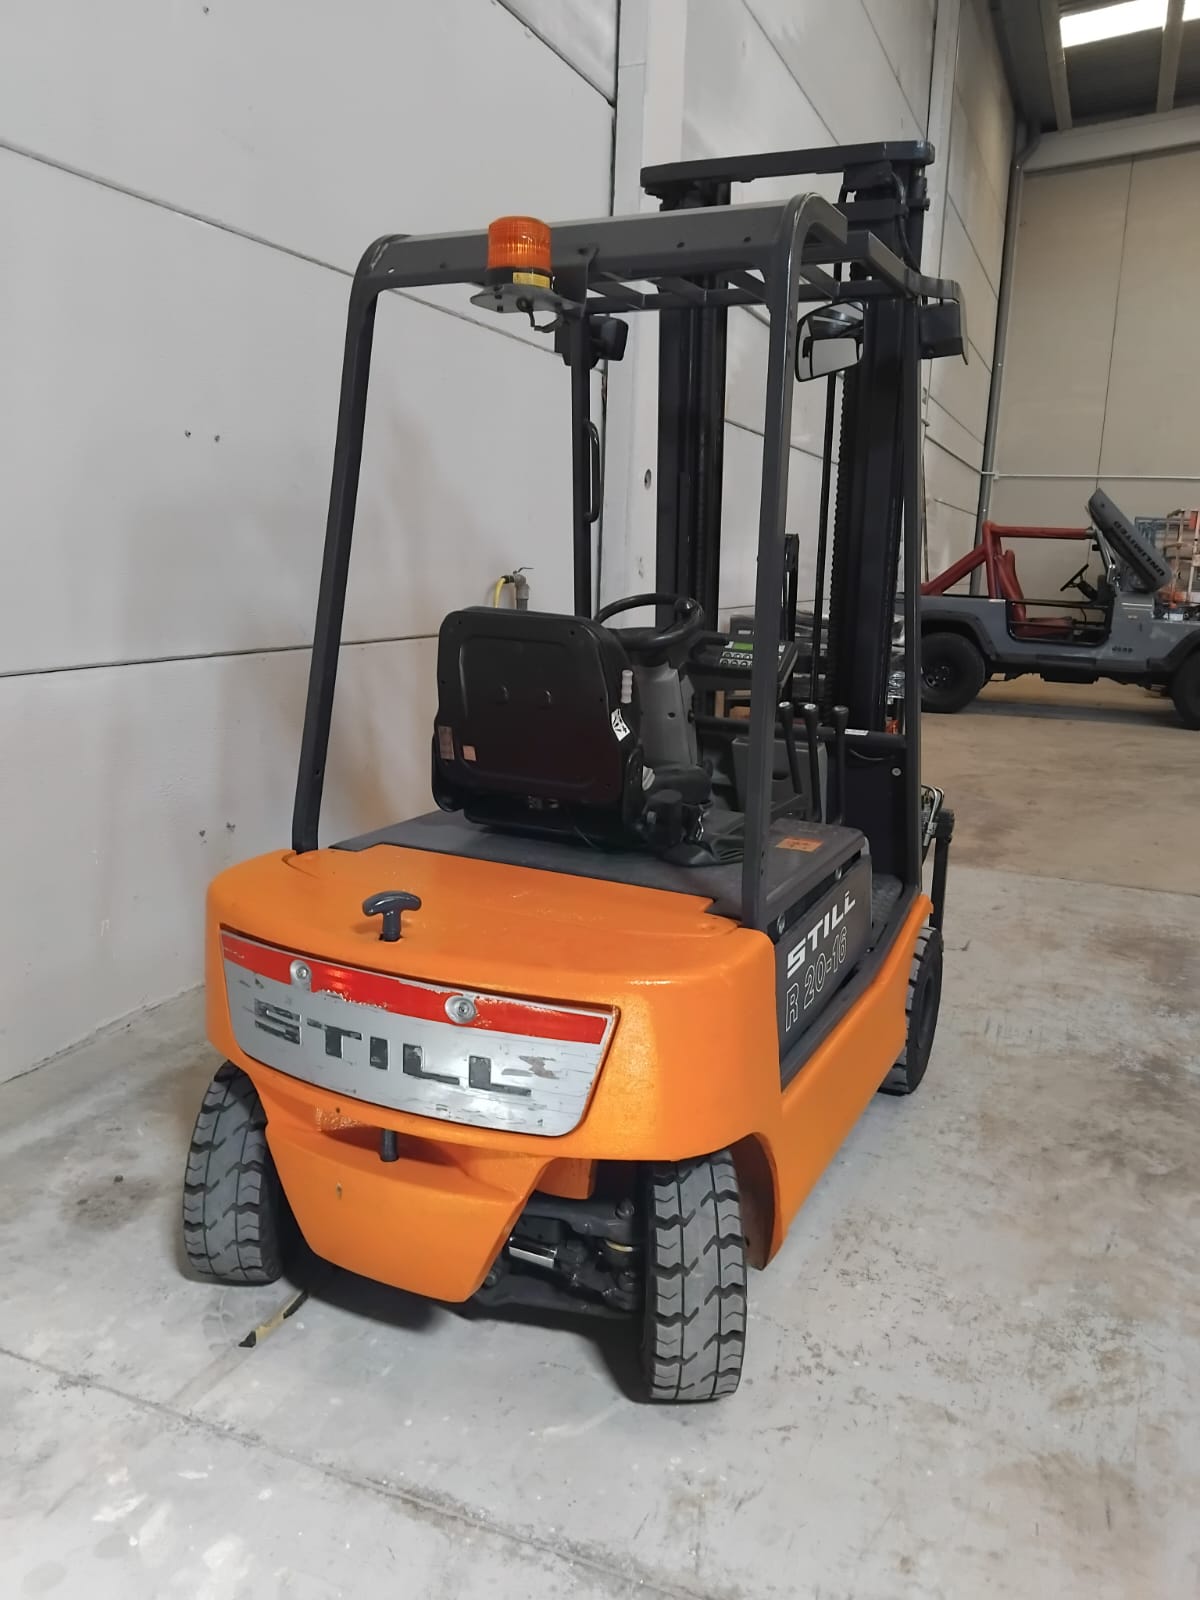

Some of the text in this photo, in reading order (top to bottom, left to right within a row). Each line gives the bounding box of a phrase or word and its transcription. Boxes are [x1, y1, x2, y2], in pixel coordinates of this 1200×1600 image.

[1113, 521, 1166, 577] UNLIMITED
[785, 926, 848, 1033] R 20-16
[787, 890, 856, 979] STILL
[254, 998, 533, 1097] STILL
